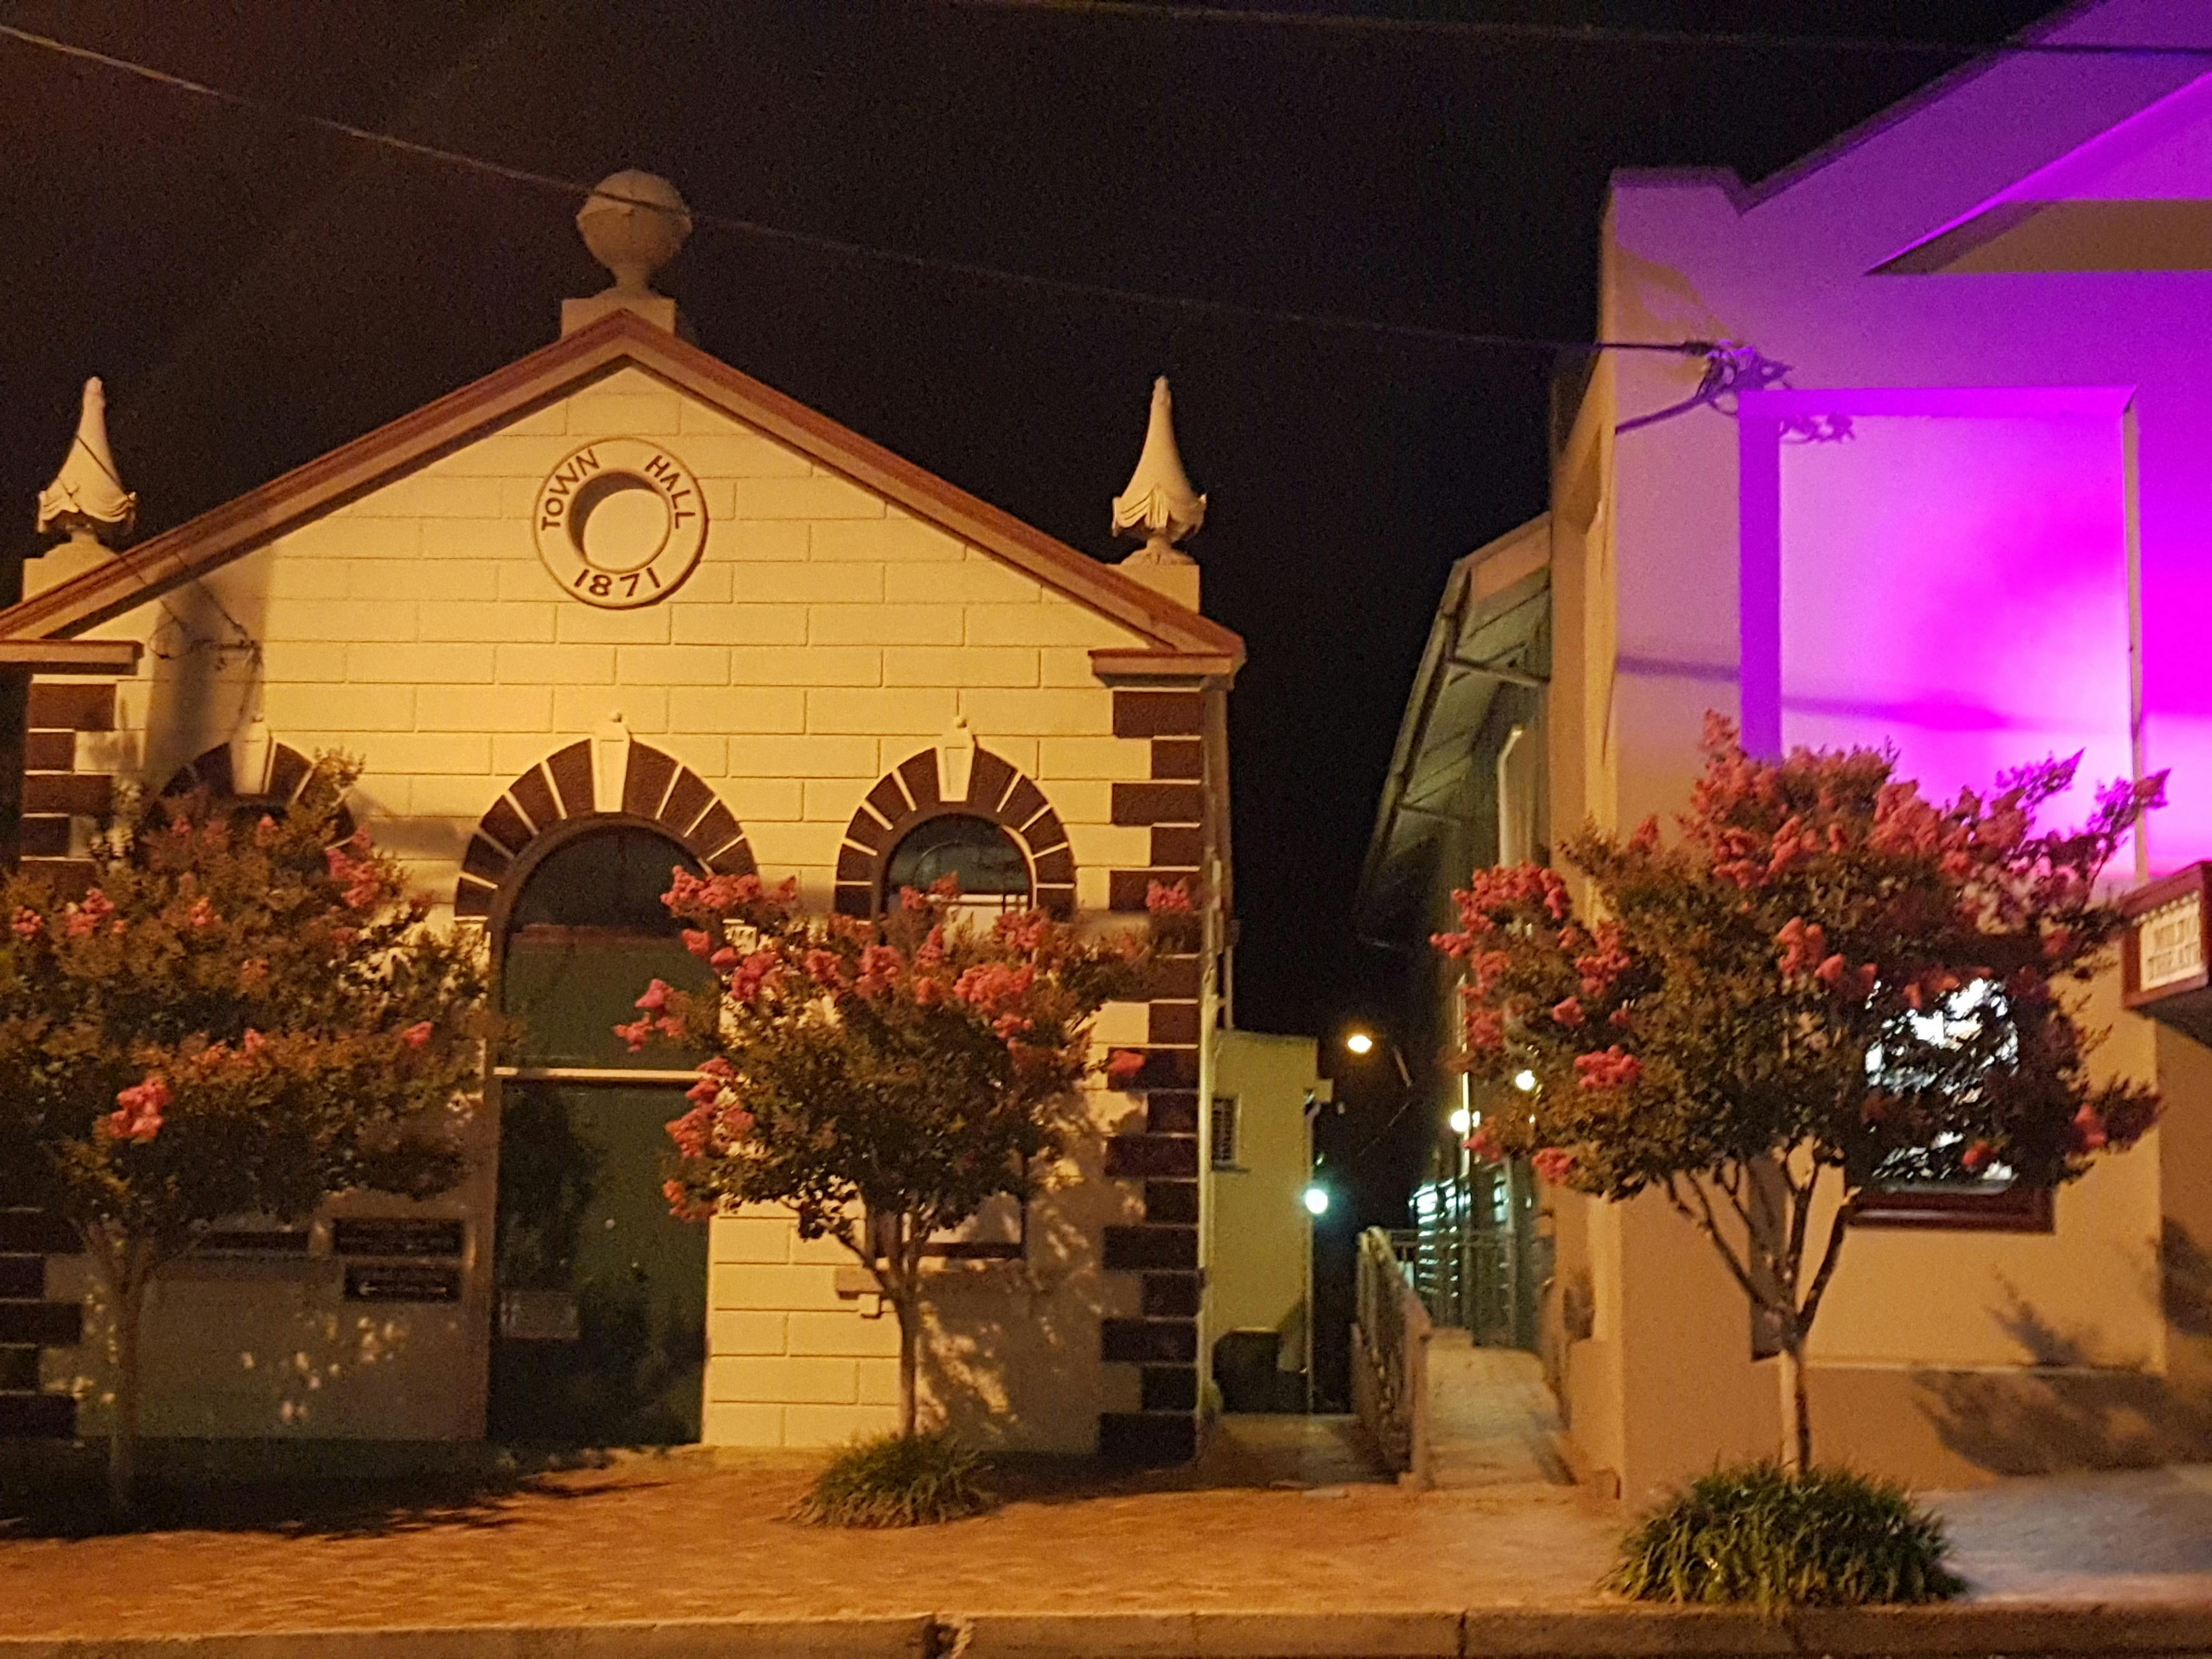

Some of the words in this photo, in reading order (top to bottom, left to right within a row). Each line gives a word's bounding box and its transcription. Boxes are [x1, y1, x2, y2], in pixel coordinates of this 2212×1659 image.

[541, 448, 600, 531] TOWN
[644, 455, 696, 529] HALL
[574, 567, 661, 597] 1871
